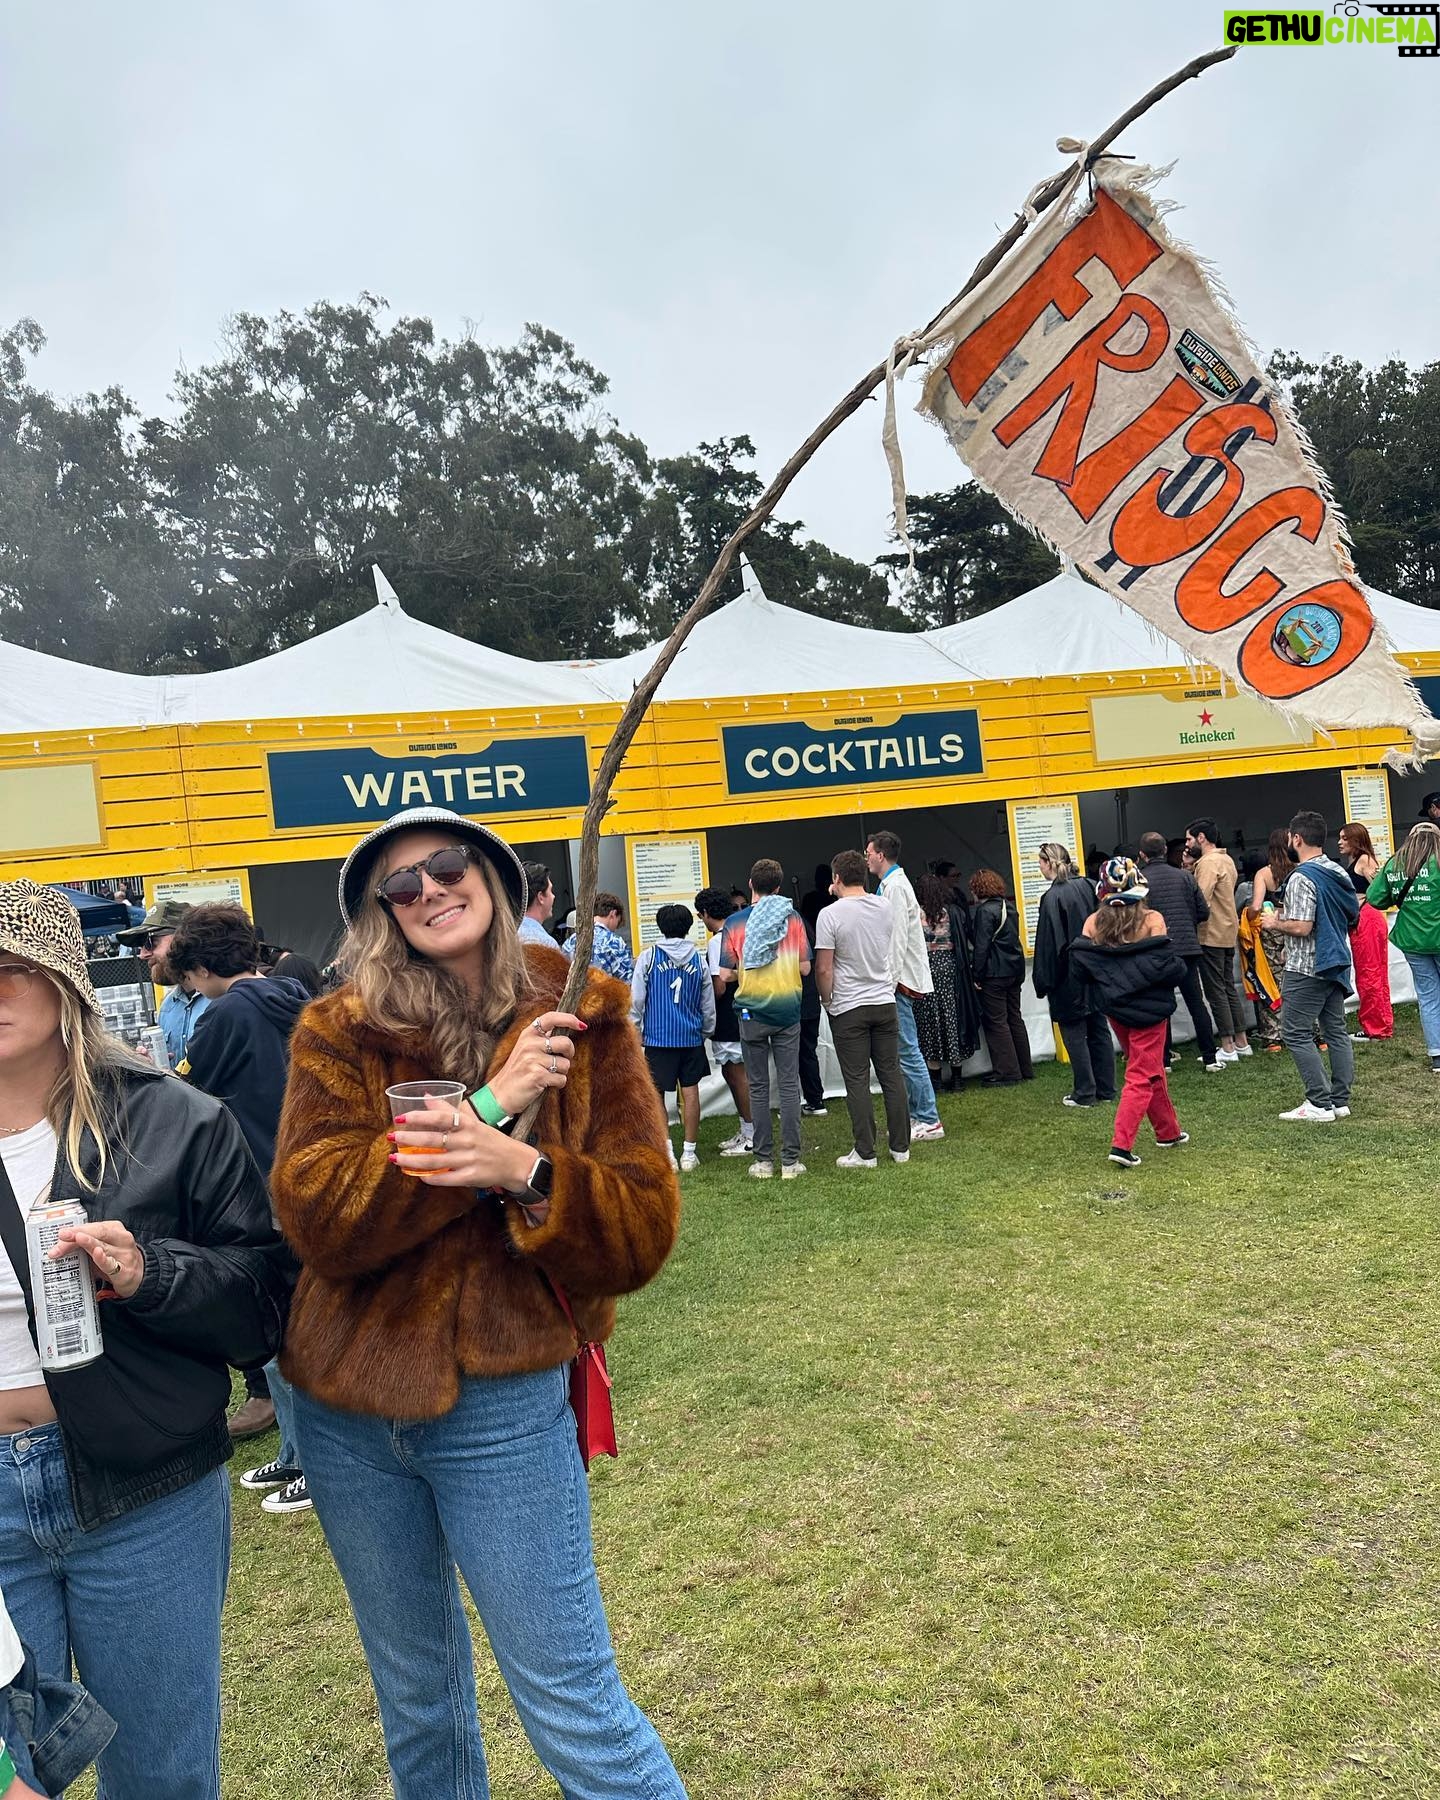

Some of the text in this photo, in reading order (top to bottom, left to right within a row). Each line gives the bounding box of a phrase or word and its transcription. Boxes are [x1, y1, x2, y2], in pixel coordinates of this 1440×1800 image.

[1181, 333, 1239, 391] OUTSIDE LANDS
[408, 742, 458, 752] OUTSIDE LANDS
[1179, 729, 1236, 745] Heineken
[744, 733, 965, 779] COCKTAILS
[342, 764, 527, 808] WATER
[669, 976, 683, 1004] 1
